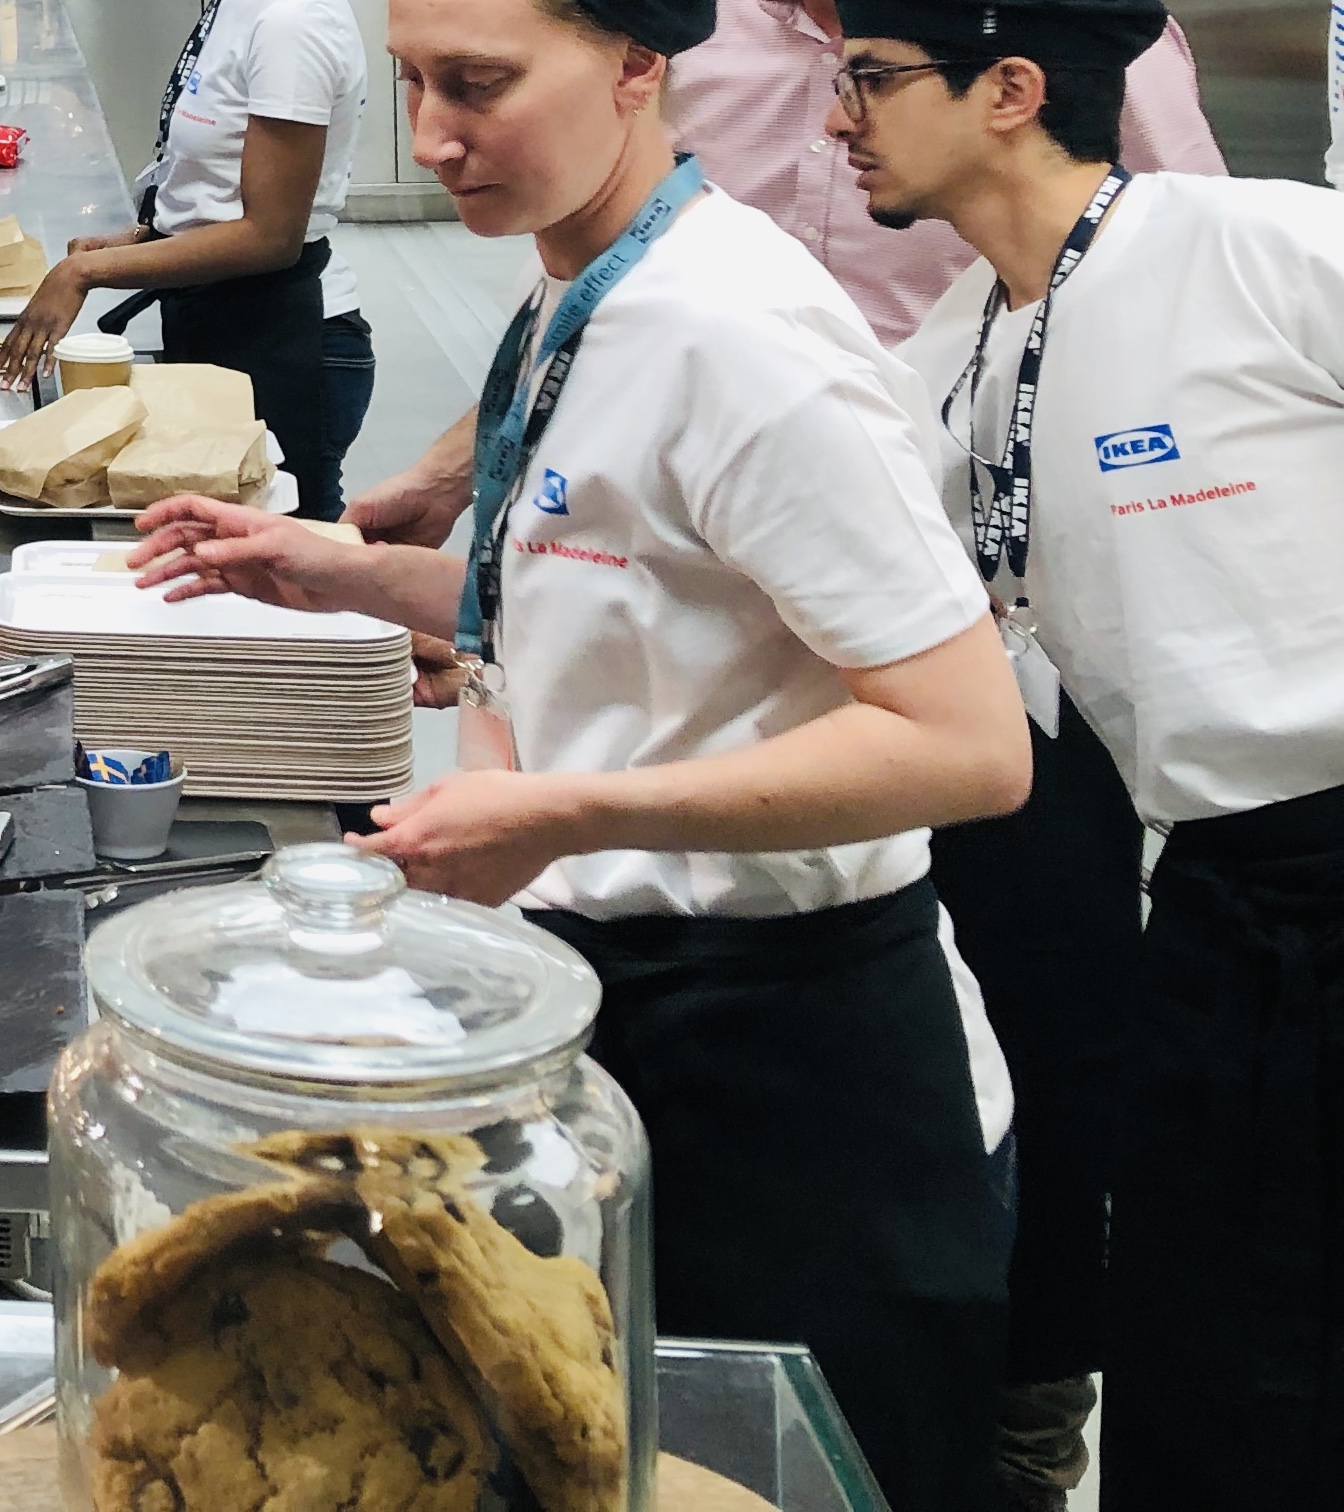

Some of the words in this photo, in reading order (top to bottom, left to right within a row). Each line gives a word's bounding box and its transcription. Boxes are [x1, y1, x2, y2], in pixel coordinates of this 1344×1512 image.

[1083, 175, 1124, 220] IKEA
[1016, 383, 1035, 443] IKEA
[1102, 436, 1169, 460] IKEA
[1011, 477, 1029, 538] IKEA
[1110, 500, 1145, 516] Paris
[1146, 498, 1168, 511] La
[1170, 480, 1258, 507] Madeleine
